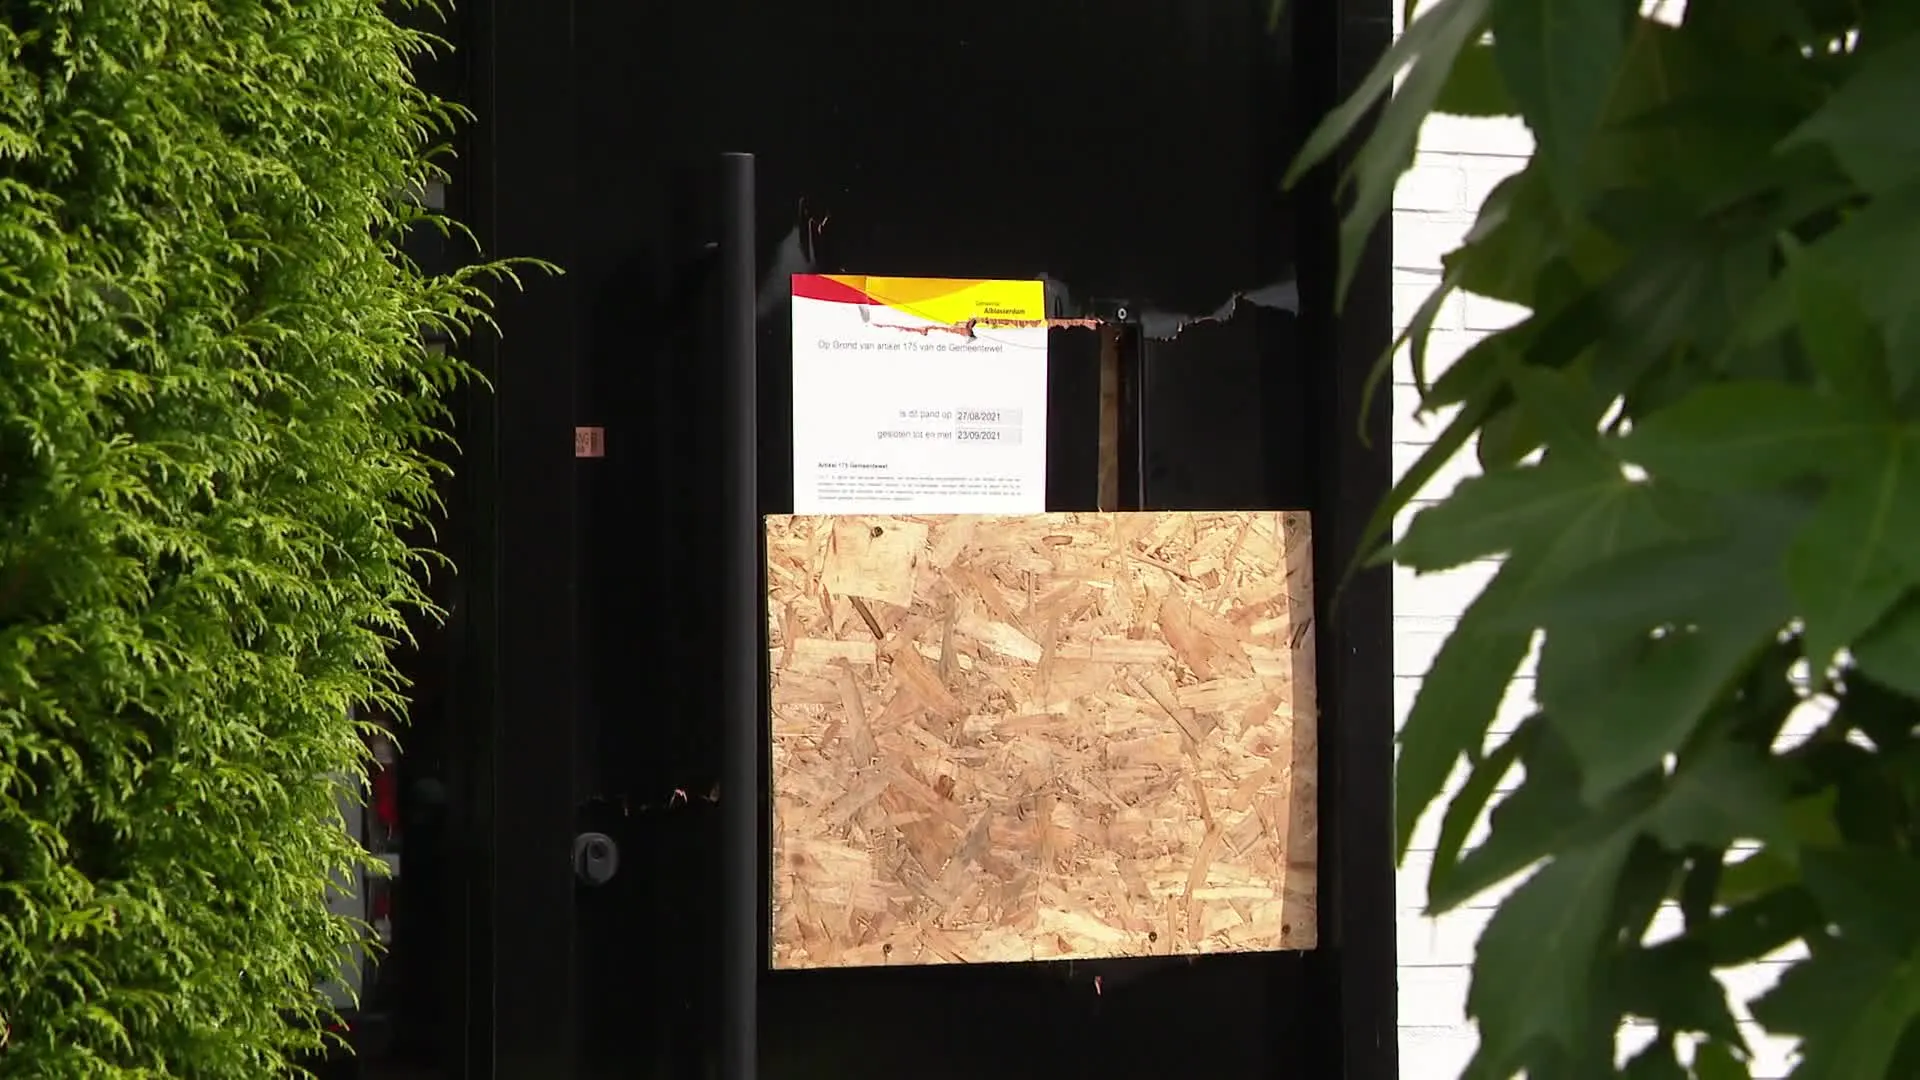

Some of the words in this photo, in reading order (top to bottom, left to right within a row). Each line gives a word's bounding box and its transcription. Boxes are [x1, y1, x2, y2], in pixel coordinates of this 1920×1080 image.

[818, 340, 831, 352] Op
[833, 340, 857, 350] Grond
[860, 342, 875, 350] van
[903, 342, 918, 352] 175
[920, 344, 934, 352] van
[936, 343, 947, 352] de
[949, 343, 1003, 354] Gemeentewet
[909, 409, 918, 418] dit
[920, 410, 940, 420] pand
[942, 411, 952, 420] op
[958, 411, 1000, 421] 27/08/2021
[877, 430, 911, 440] gesloten
[913, 431, 923, 439] tot
[937, 431, 952, 440] met
[958, 431, 1000, 440] 23/09/2021
